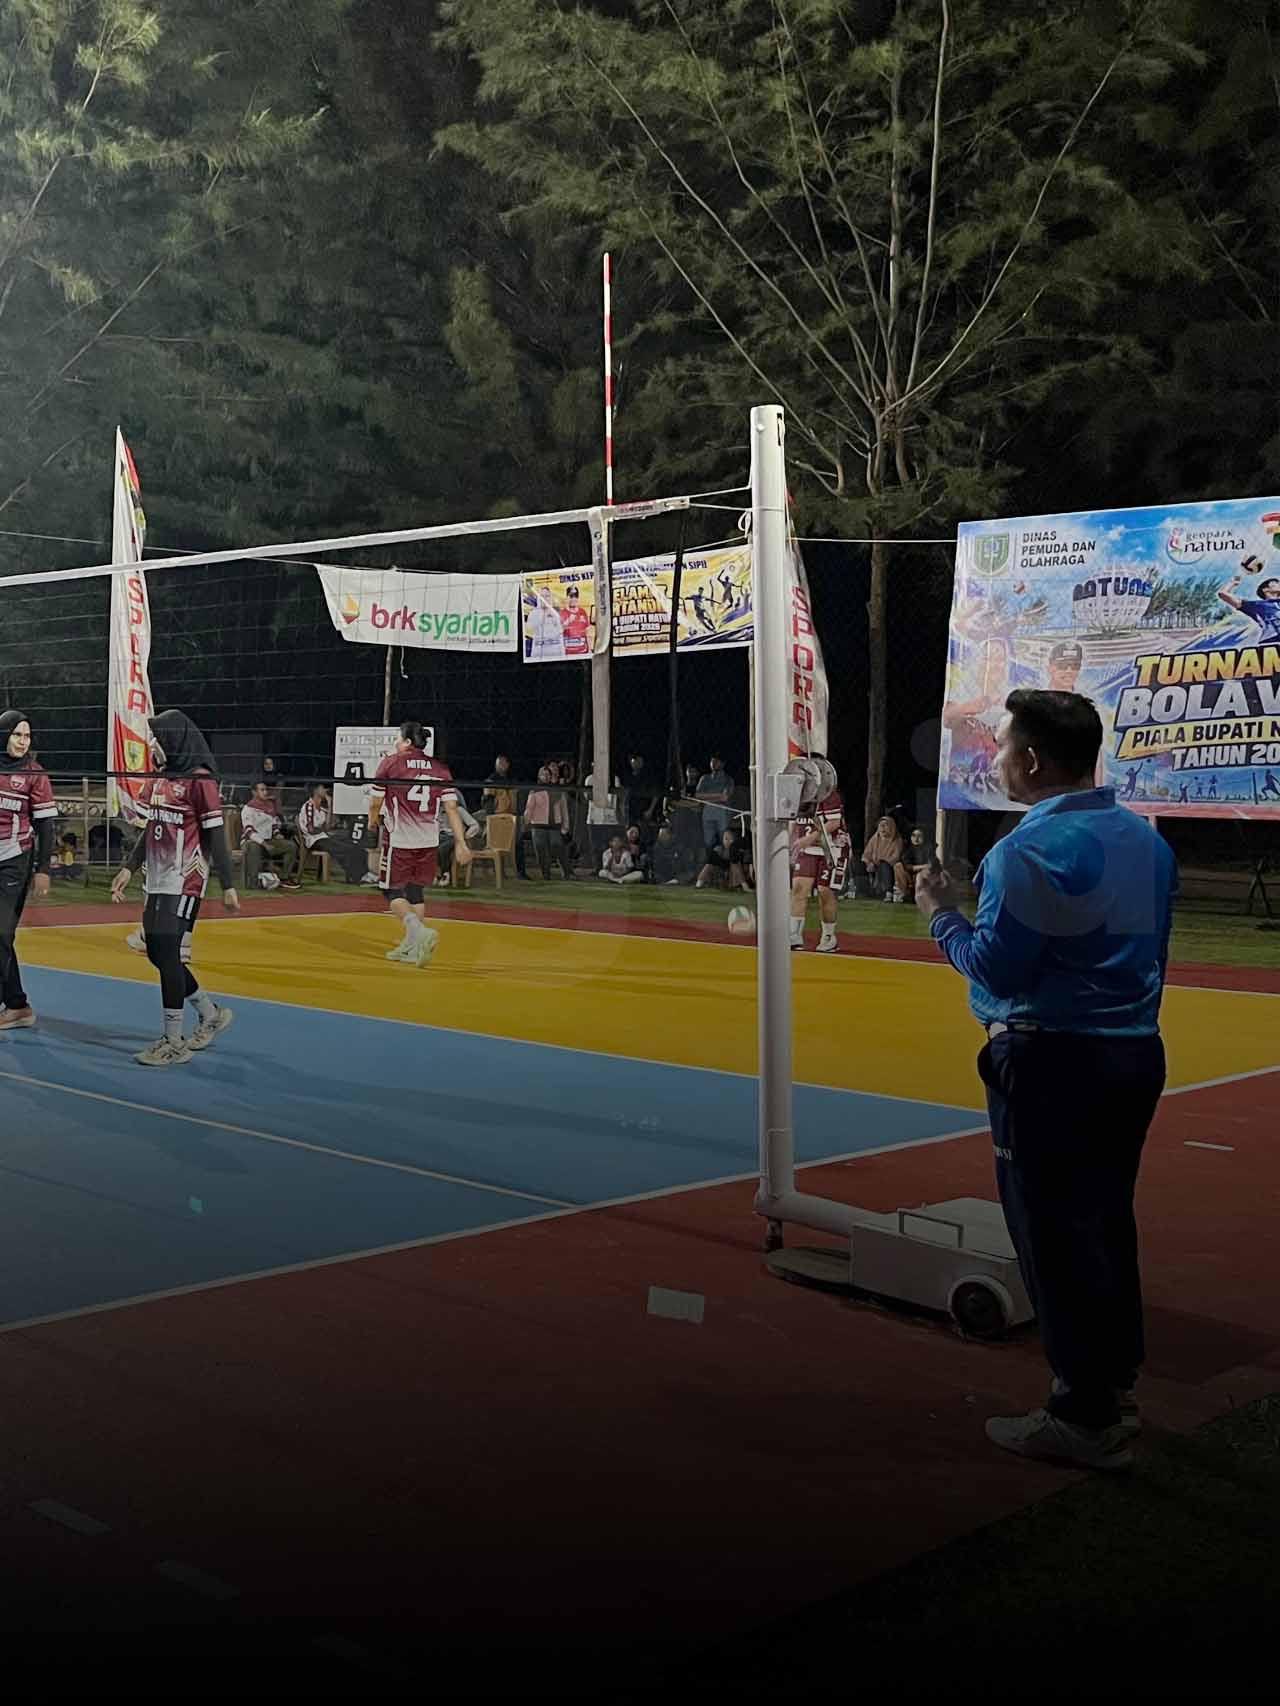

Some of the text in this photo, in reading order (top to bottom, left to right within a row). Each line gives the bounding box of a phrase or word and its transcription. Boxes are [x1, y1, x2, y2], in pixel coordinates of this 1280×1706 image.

[1022, 530, 1058, 543] DINAS
[1185, 529, 1233, 544] geopark
[1021, 539, 1096, 556] PEMUDA DAN
[1183, 537, 1246, 554] natuna
[1020, 554, 1086, 568] OLAHRAGA
[1117, 680, 1250, 727] BOLA
[1132, 727, 1186, 749] PIALA
[1192, 721, 1263, 742] BUPATI
[1173, 743, 1280, 771] TAHUN 20
[407, 774, 433, 813] 4
[154, 824, 163, 841] 9
[822, 871, 829, 880] 2
